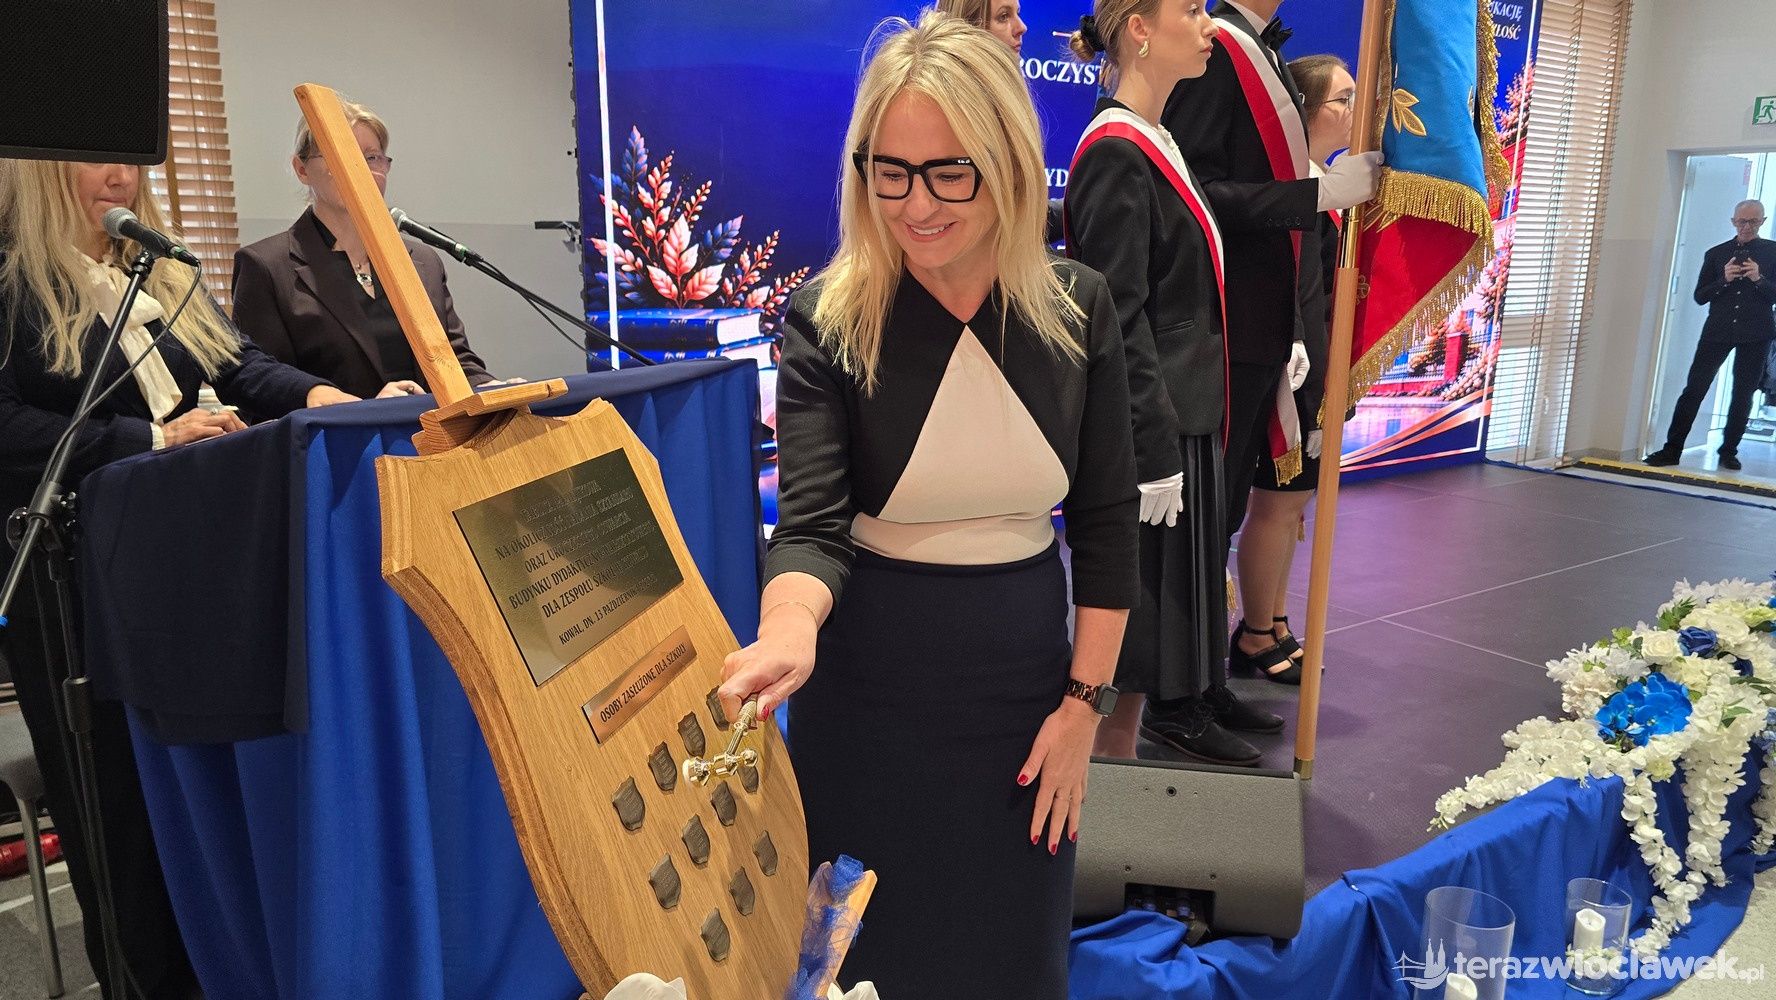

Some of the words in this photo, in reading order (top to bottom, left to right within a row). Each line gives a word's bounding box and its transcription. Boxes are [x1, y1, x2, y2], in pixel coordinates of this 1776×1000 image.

[494, 543, 511, 561] NA
[522, 552, 548, 574] ORAZ
[508, 576, 553, 610] BUDYNKU
[541, 598, 561, 618] DLA
[558, 578, 594, 608] ZESPOŁU
[582, 613, 596, 629] DN.
[593, 608, 604, 621] 13
[599, 696, 623, 723] OSOBY
[621, 668, 656, 704] ZASŁUŻONE
[654, 657, 668, 675] DLA
